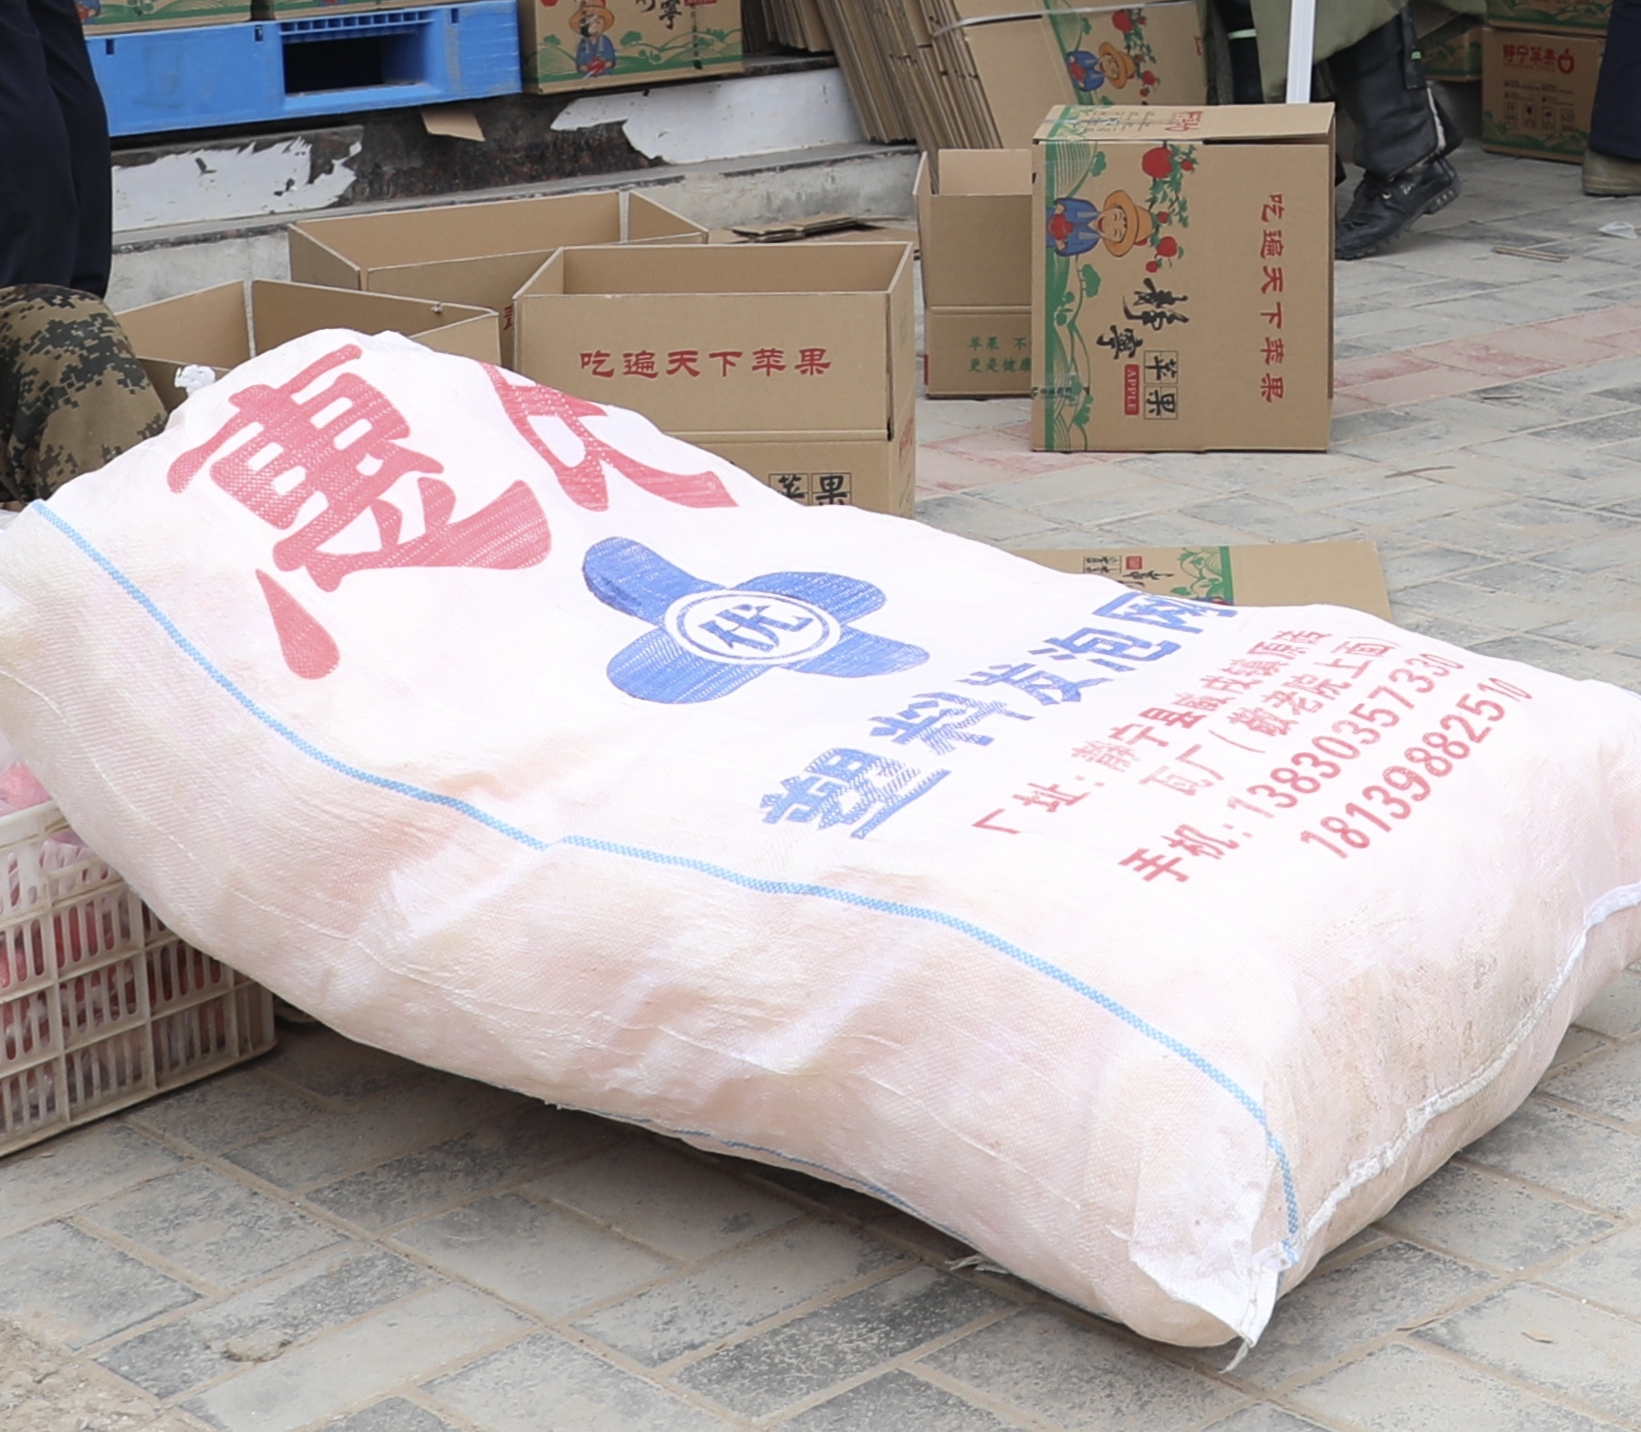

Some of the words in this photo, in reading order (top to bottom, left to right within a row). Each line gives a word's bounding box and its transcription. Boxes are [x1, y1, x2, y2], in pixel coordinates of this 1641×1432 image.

[1259, 192, 1286, 403] 吃遍天下苹果
[578, 347, 833, 380] 吃遍天下苹果
[1126, 368, 1137, 411] APPLE
[1146, 354, 1179, 417] 苹果
[709, 606, 814, 652] 优
[759, 591, 1239, 840] 塑料发泡网
[1299, 676, 1534, 860] 18139882510
